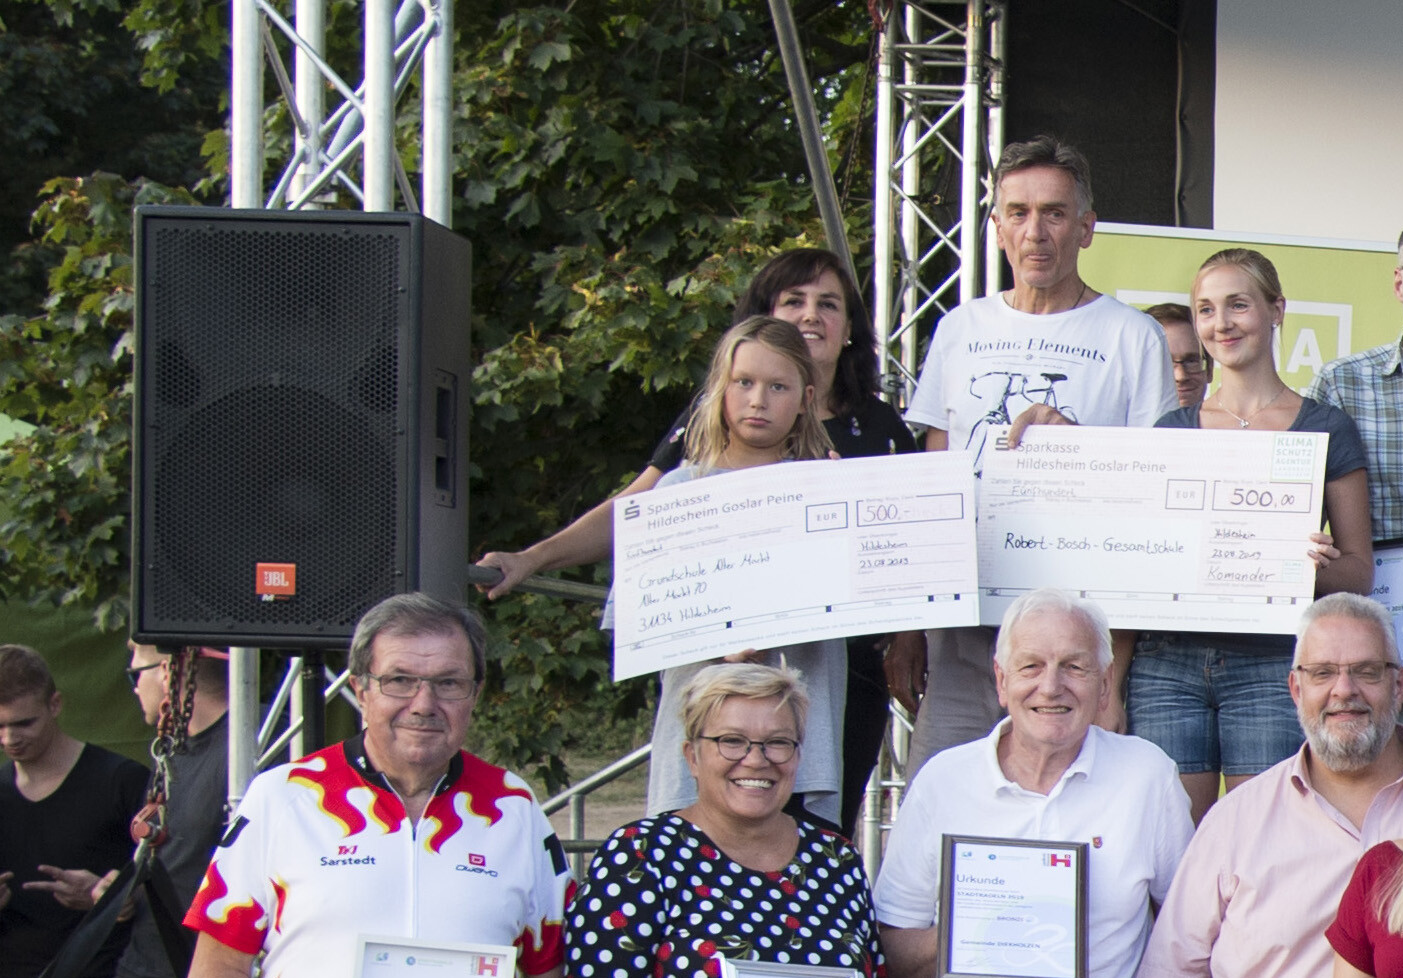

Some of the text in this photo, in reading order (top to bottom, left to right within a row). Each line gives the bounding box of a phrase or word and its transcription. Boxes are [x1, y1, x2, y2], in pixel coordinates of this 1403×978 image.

[1027, 338, 1107, 362] Elements
[1017, 441, 1080, 454] Sparkasse
[1277, 437, 1313, 447] KLIMA
[1017, 459, 1167, 473] Hildesheim Goslar Peine
[647, 493, 710, 515] Sparkasse
[648, 492, 804, 530] Hildesheim Goslar Peine
[264, 571, 289, 586] JBL
[320, 856, 376, 866] Sarstedt
[956, 874, 1005, 886] Urkunde
